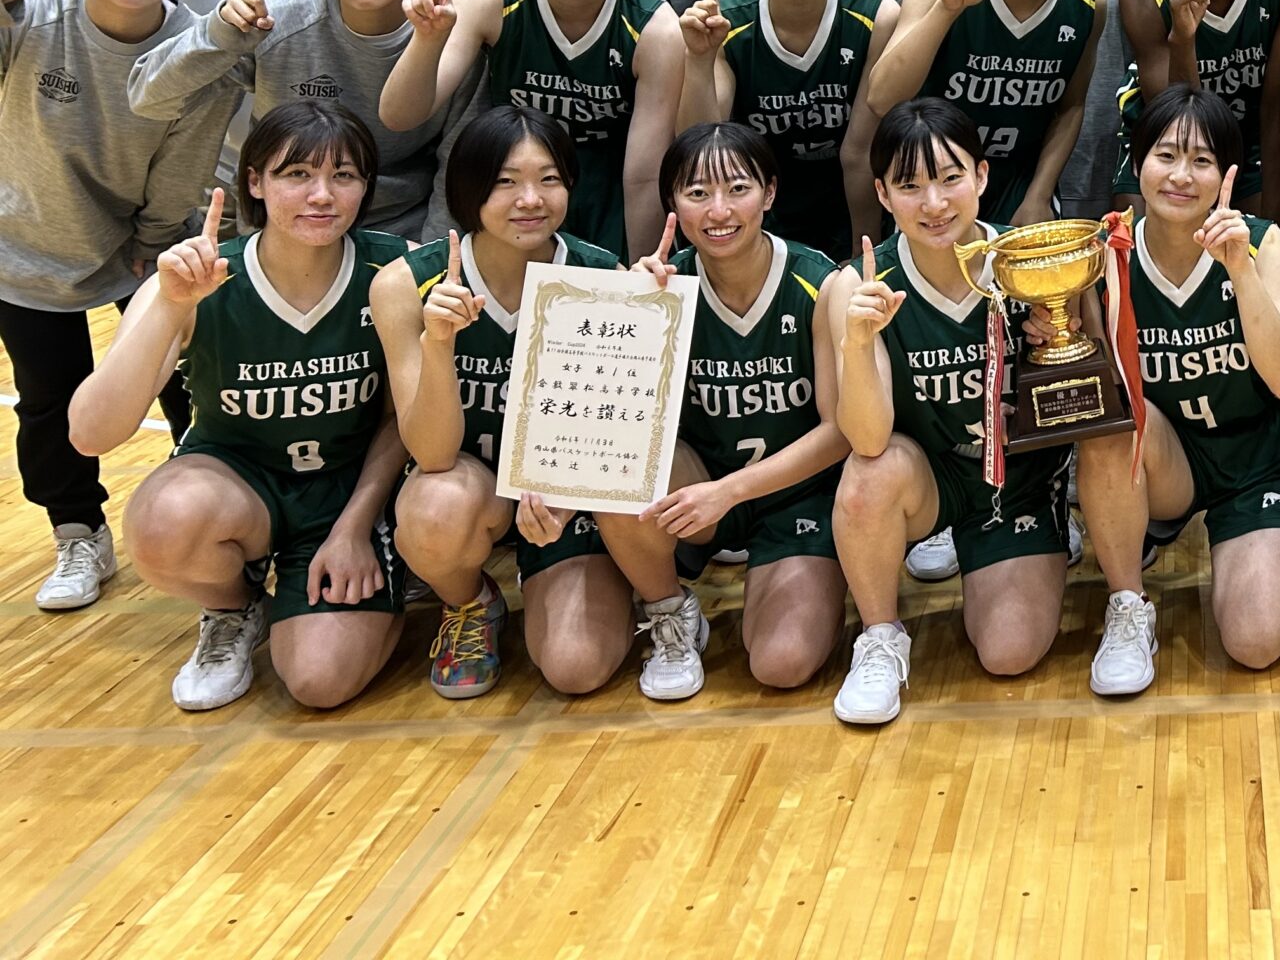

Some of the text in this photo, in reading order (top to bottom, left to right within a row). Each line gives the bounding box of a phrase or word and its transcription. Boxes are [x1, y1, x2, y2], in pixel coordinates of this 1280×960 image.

[966, 53, 1063, 75] KURASHIKI
[38, 73, 79, 95] SUISHO
[944, 71, 1067, 107] SUISHO
[747, 103, 852, 136] SUISH
[577, 318, 637, 339] 表彰状
[237, 350, 371, 381] KURASHIKI
[691, 357, 794, 378] KURASHIKI
[907, 336, 1022, 369] KURASHKI
[1138, 343, 1251, 383] UISHO
[219, 371, 380, 420] SUISHO
[689, 376, 812, 419] SUISHO
[1179, 395, 1218, 429] 4
[736, 437, 767, 467] 7
